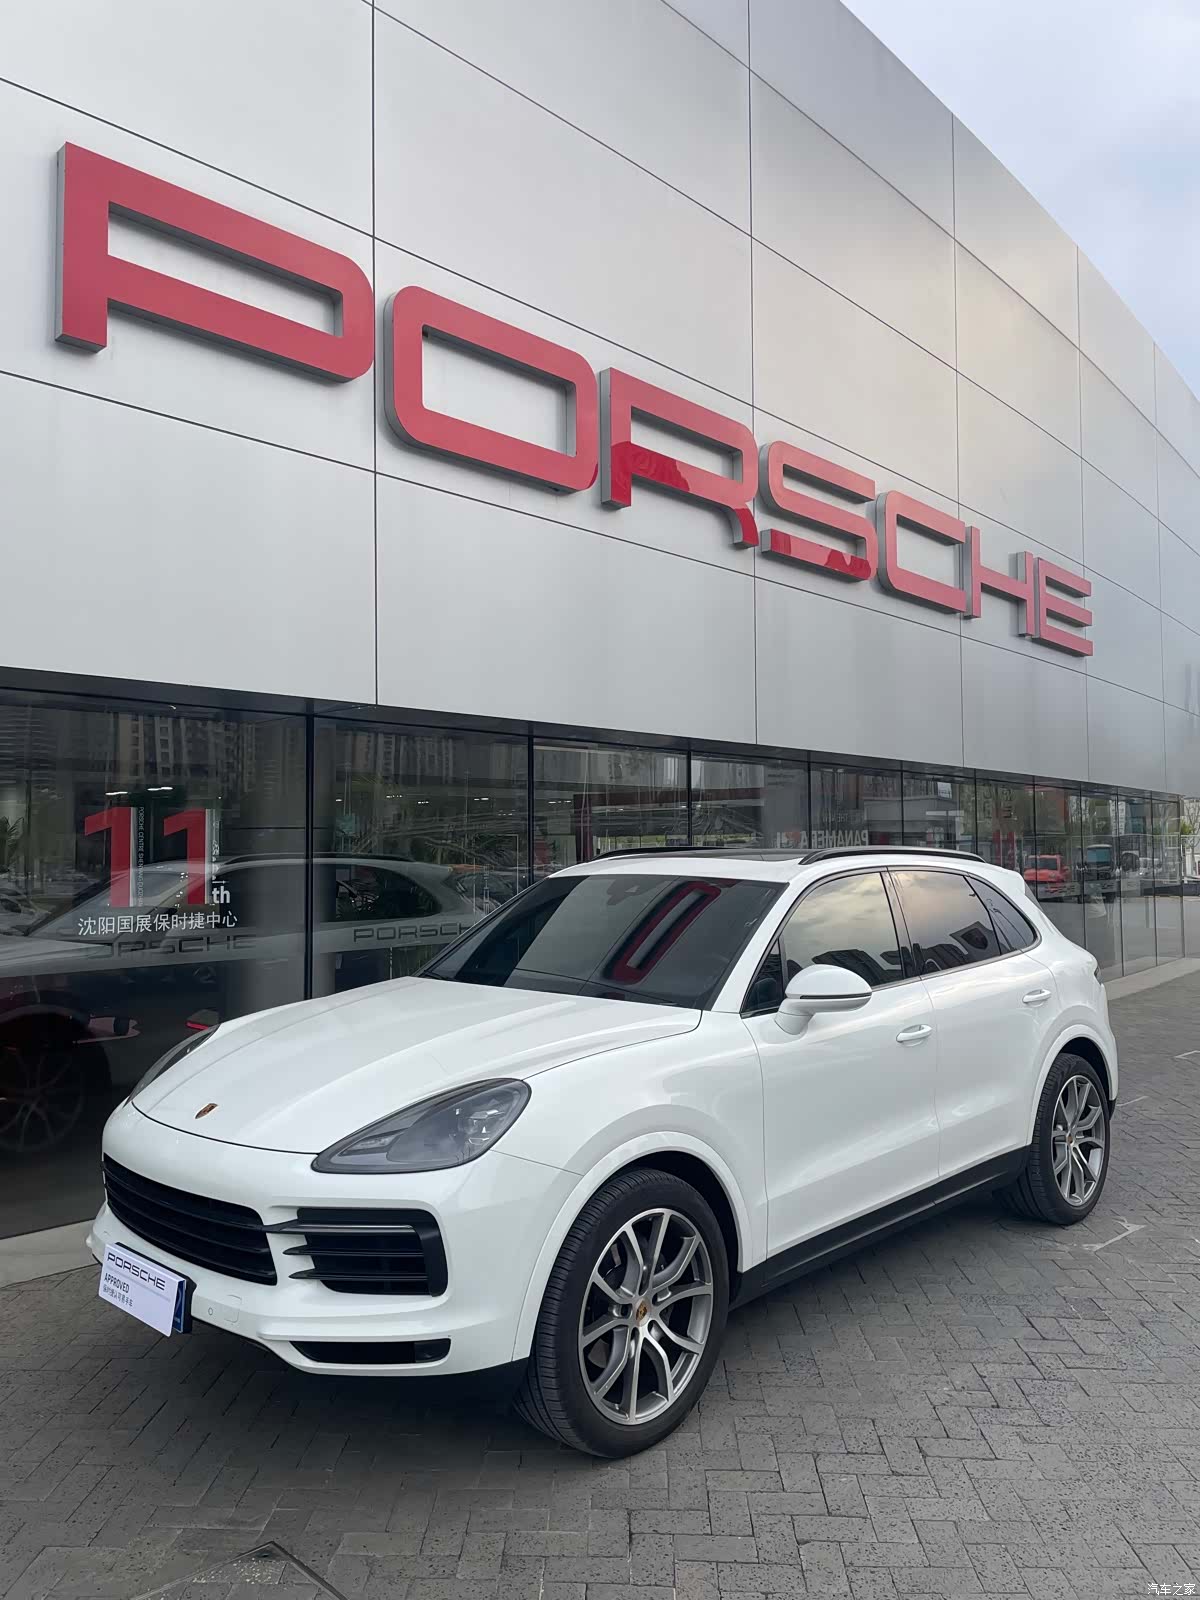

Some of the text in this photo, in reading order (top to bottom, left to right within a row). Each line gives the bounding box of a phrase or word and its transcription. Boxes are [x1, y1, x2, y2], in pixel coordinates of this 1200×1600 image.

[55, 141, 1093, 657] PORSCHE
[77, 911, 238, 936] 沈阳国展保时捷中心
[104, 1272, 130, 1294] APPROVED
[107, 1252, 166, 1291] PORSCHE
